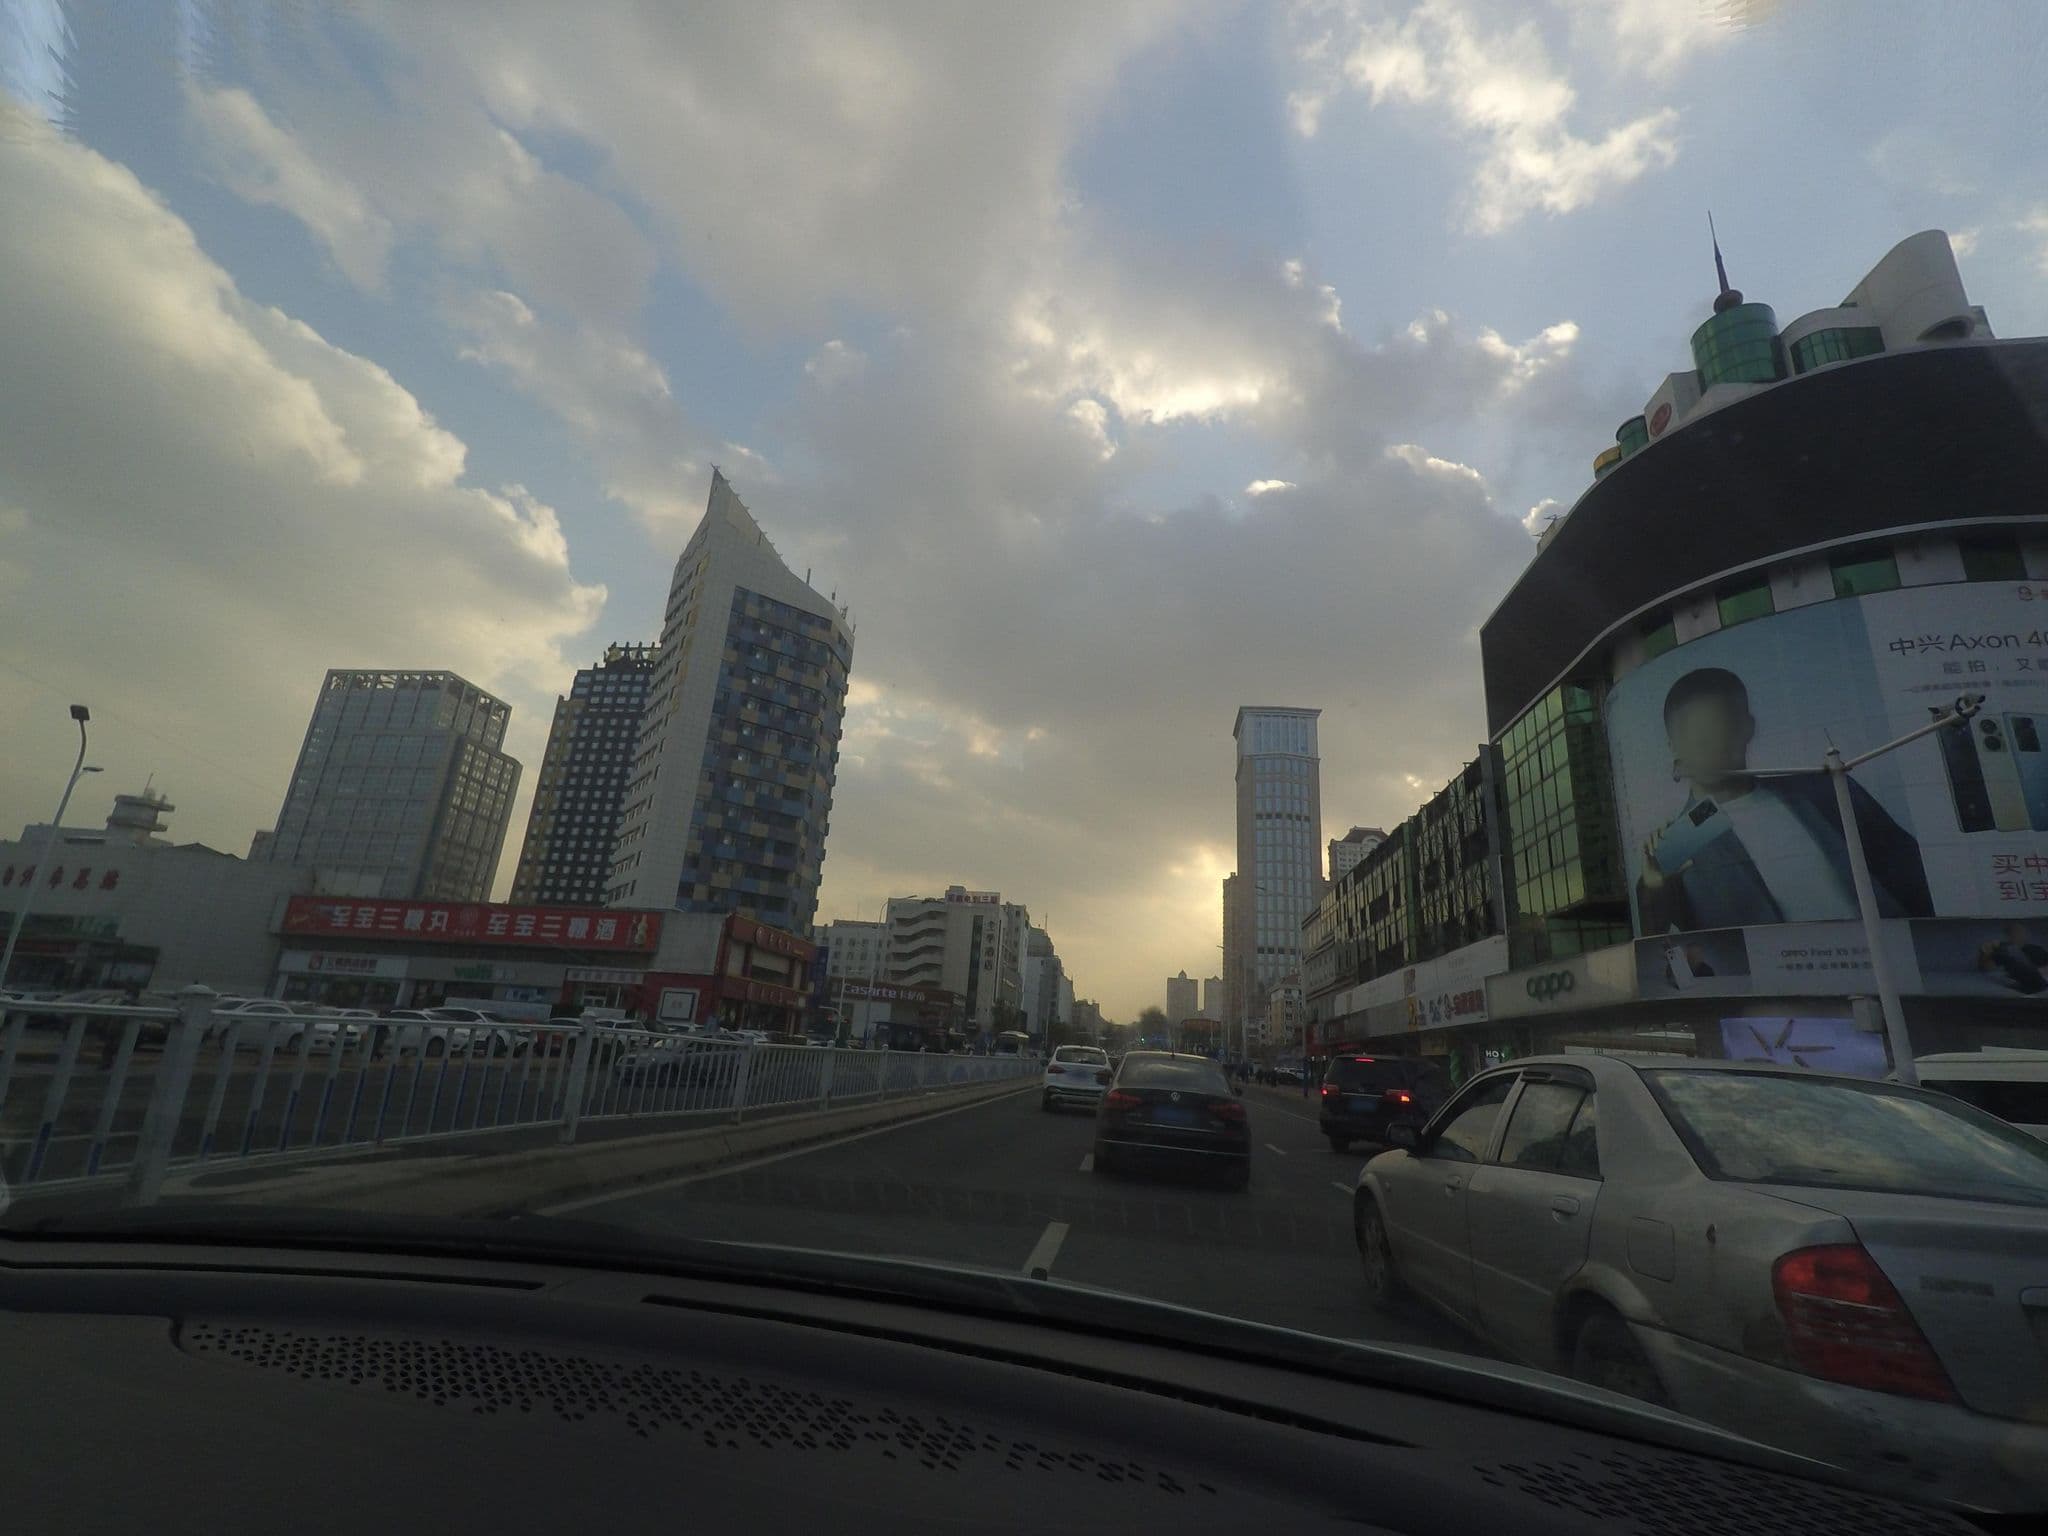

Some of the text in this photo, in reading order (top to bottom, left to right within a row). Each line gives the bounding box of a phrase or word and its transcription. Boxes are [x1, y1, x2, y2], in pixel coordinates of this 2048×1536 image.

[1889, 629, 2048, 656] 中兴 Axon 4
